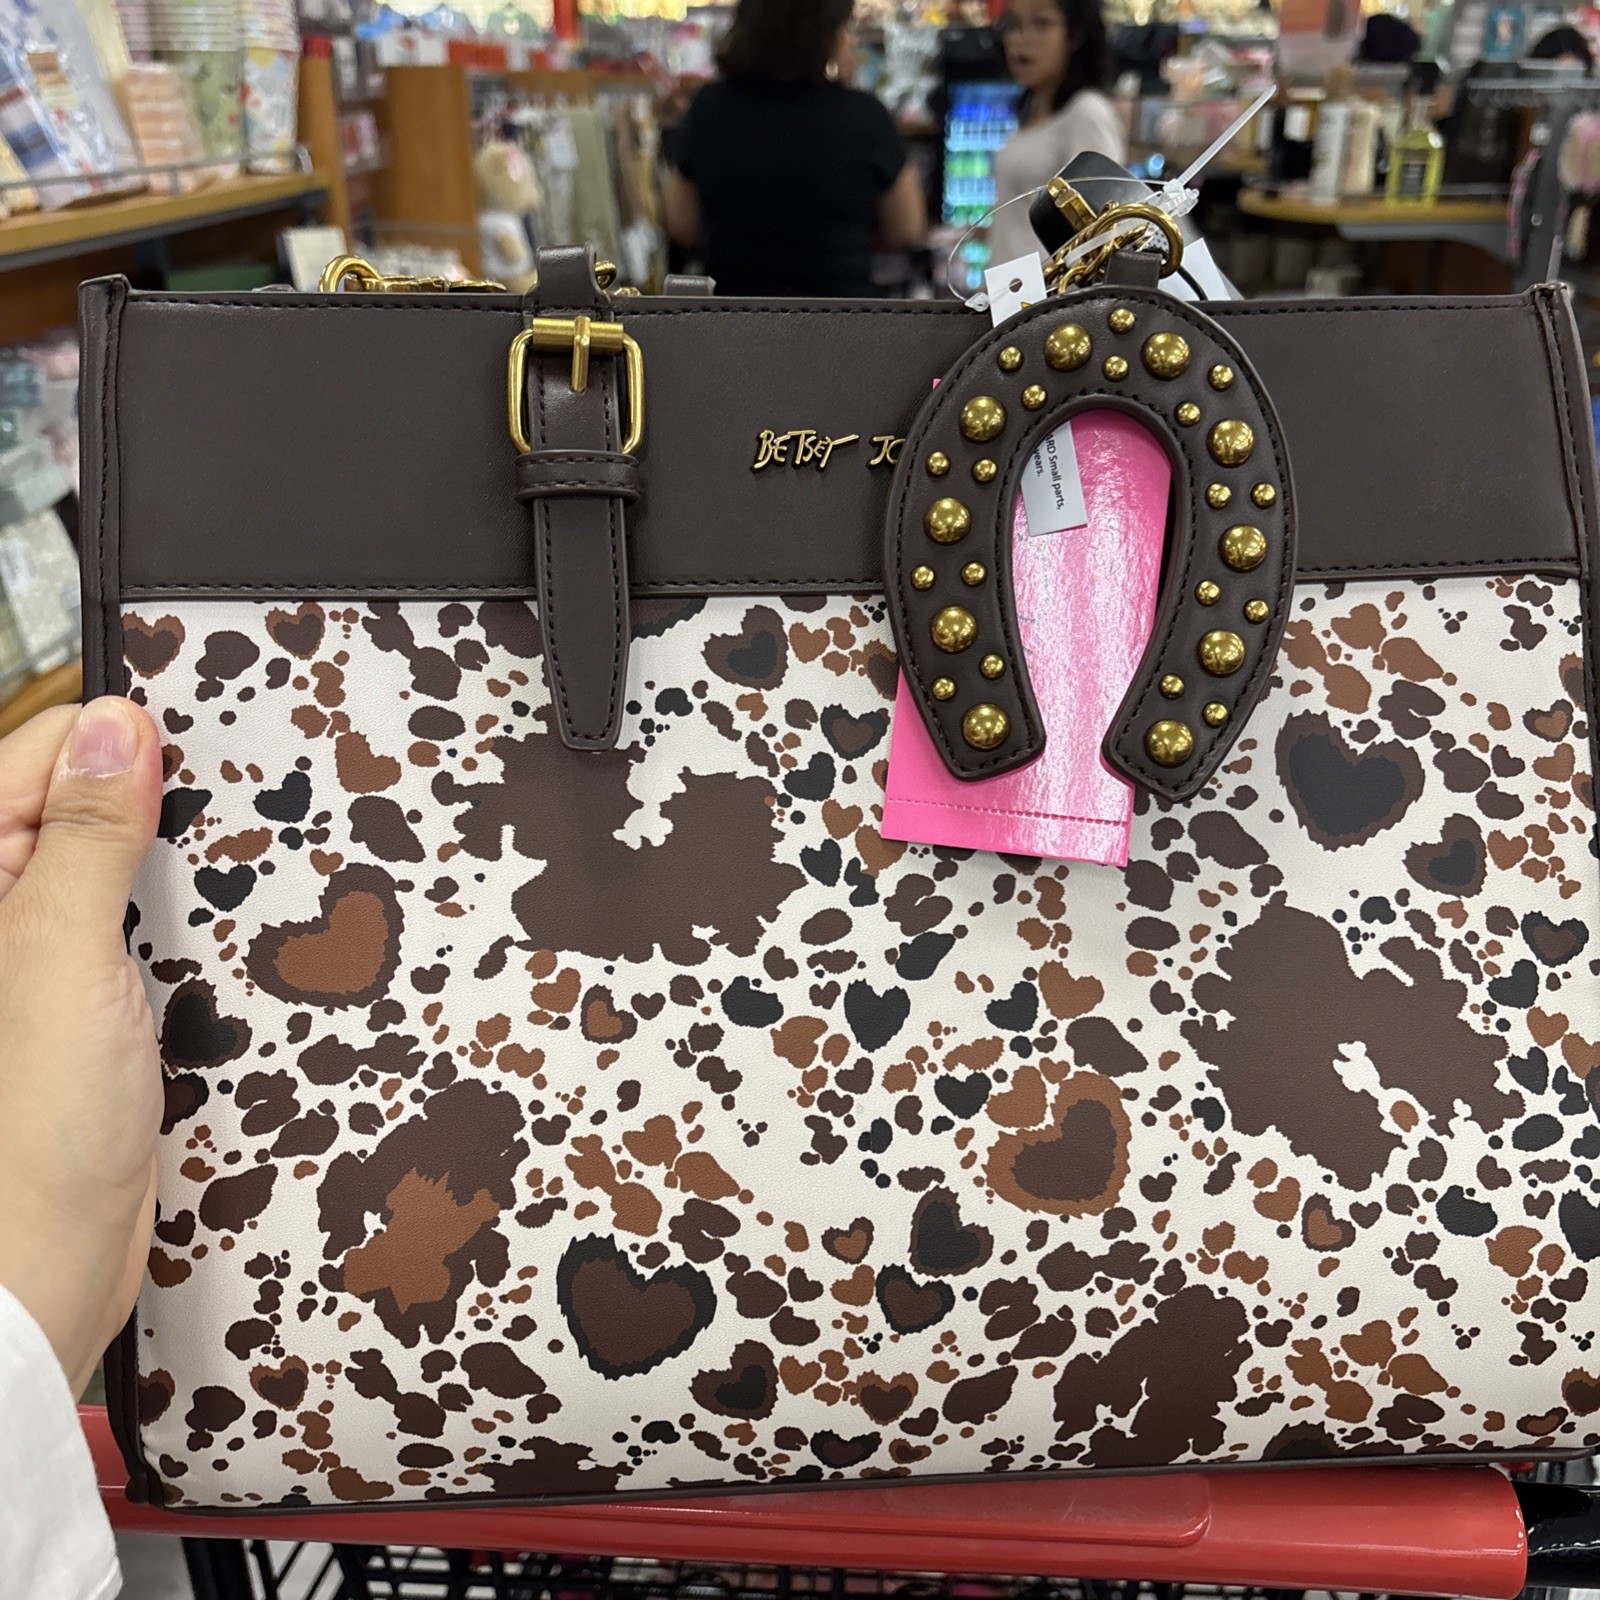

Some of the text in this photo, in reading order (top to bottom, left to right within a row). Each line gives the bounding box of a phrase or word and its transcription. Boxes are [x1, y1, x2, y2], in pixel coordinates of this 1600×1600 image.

[753, 429, 860, 469] BETSEY
[1048, 455, 1062, 482] Small
[1051, 482, 1065, 510] parts,
